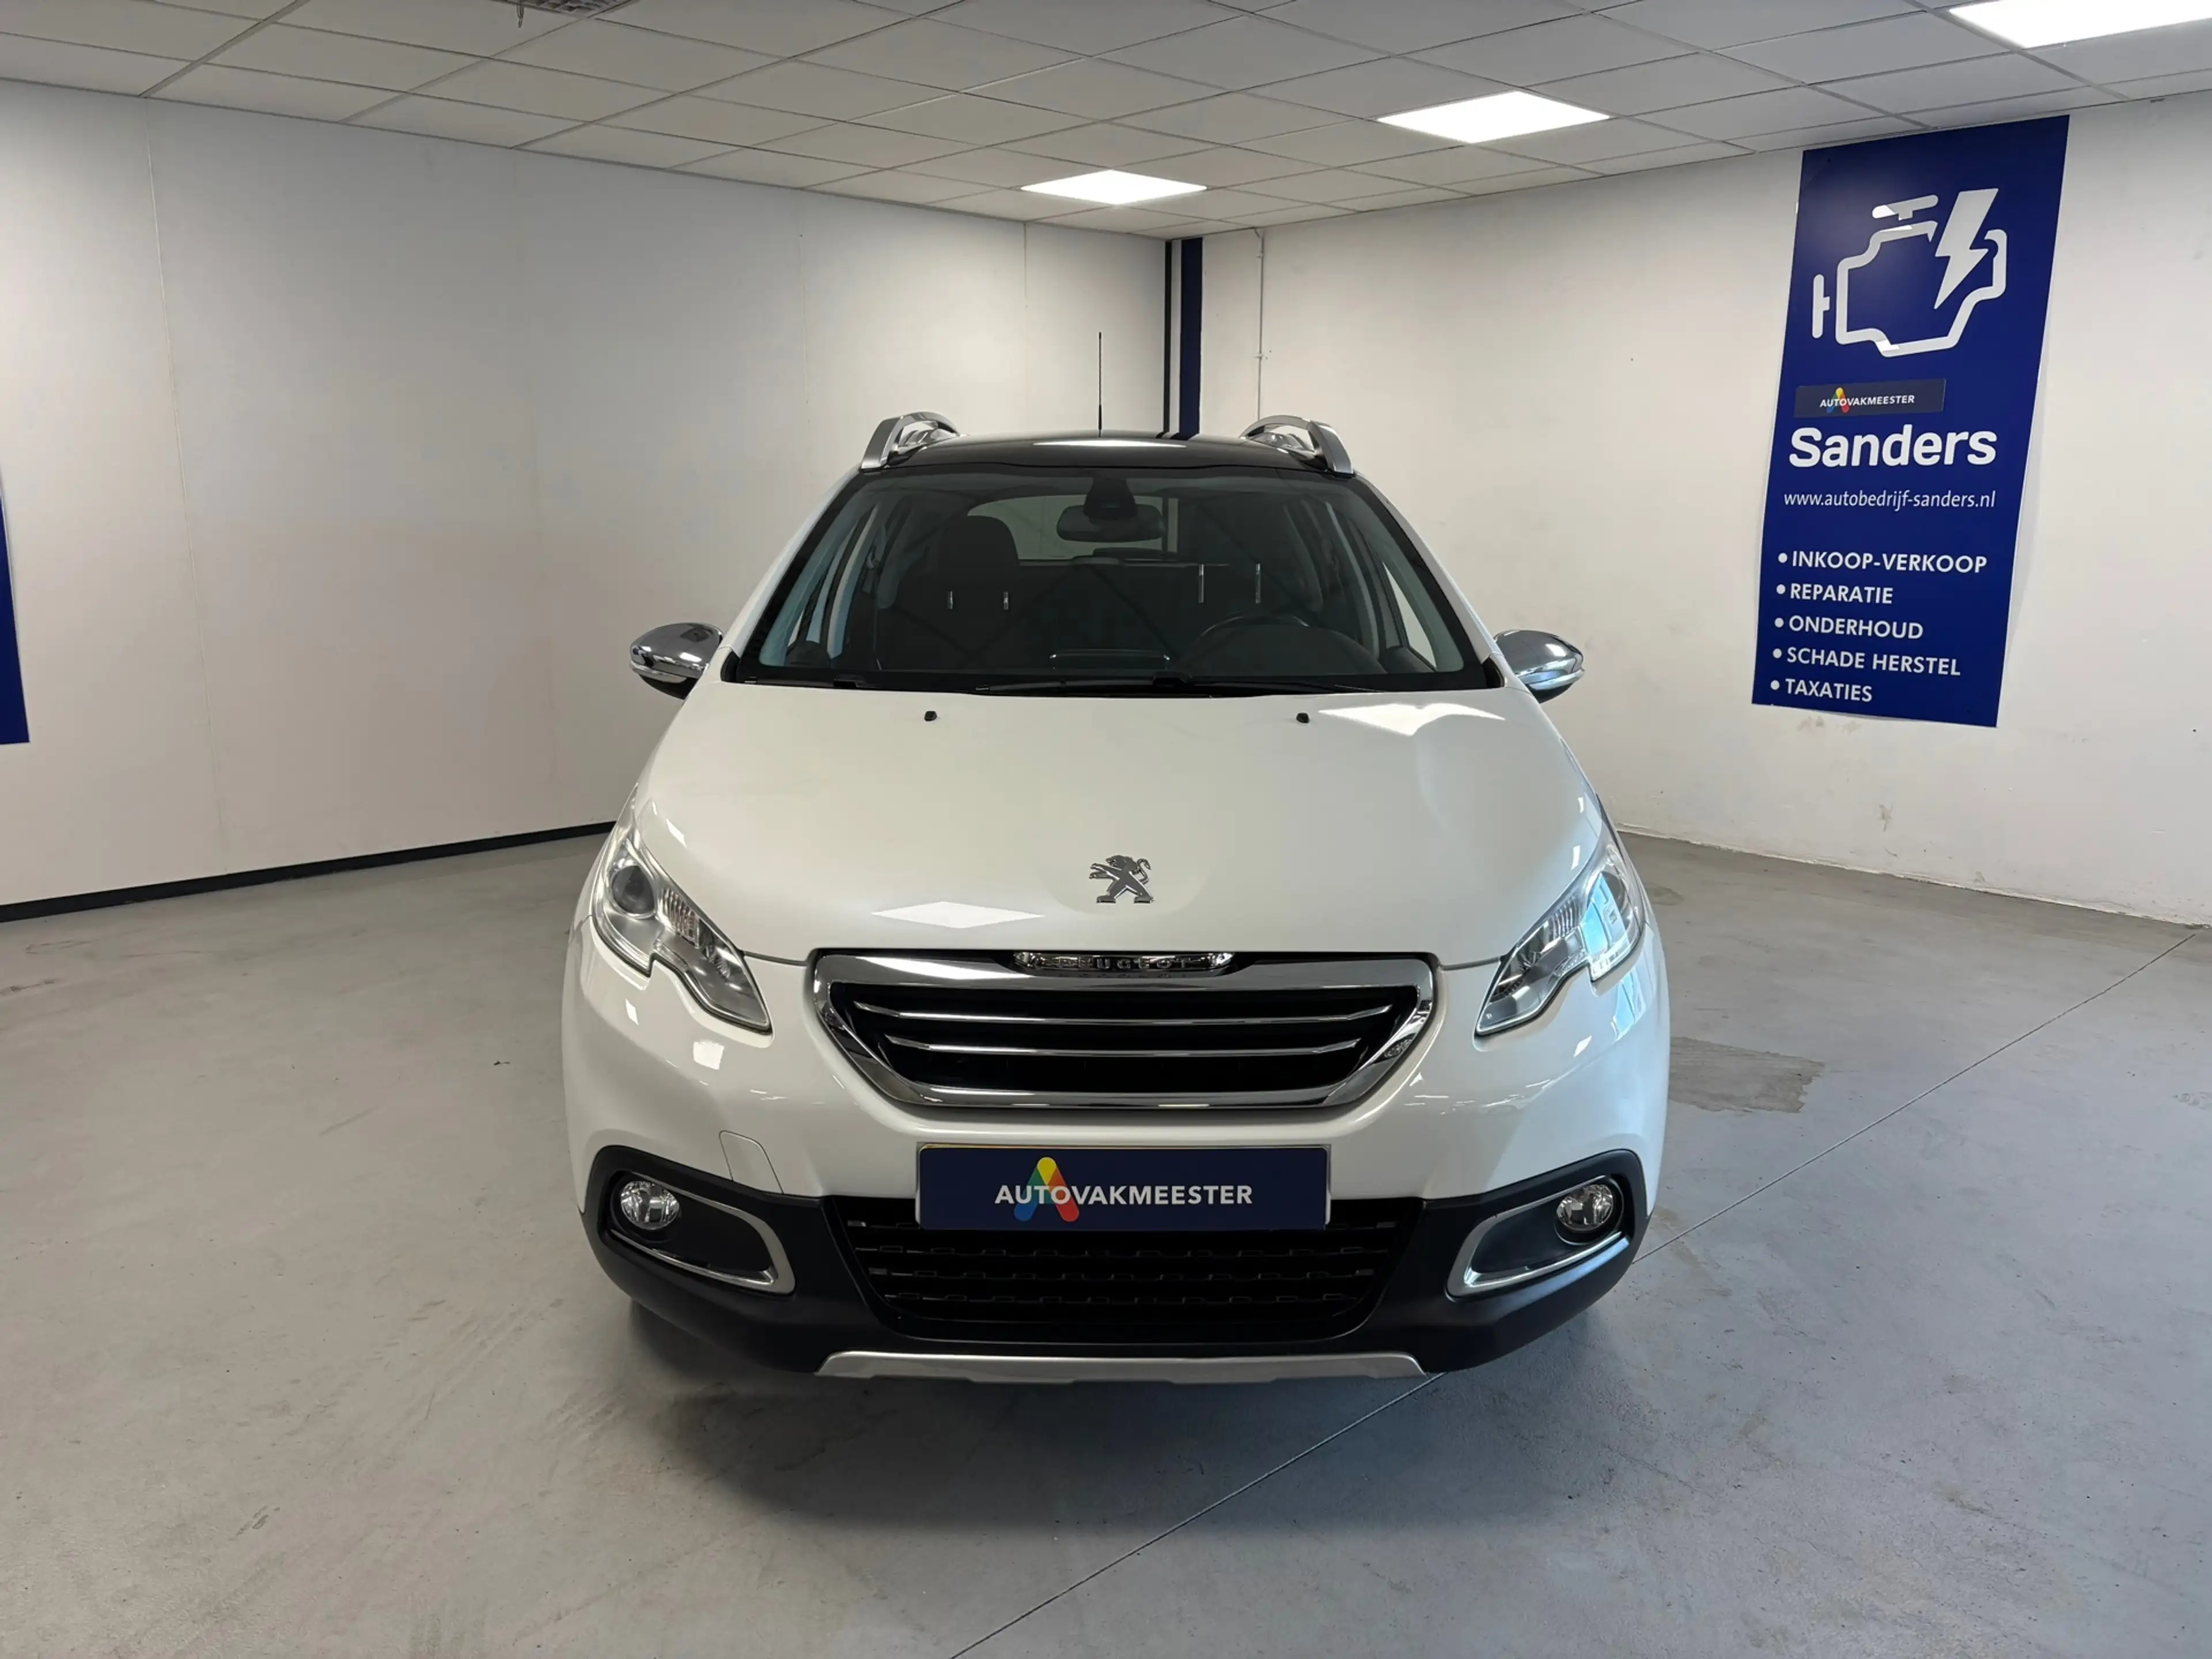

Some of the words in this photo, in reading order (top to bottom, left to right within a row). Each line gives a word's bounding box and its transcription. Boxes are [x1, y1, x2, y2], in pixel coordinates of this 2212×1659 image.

[1819, 395, 1915, 408] AUTOVAKMEESTER
[1789, 424, 1998, 468] Sanders
[1784, 490, 1996, 512] www.autobedrijf-sanders.nl
[1792, 551, 1987, 573] INKOOP-VERKOOP
[1790, 583, 1893, 604] REPARATIE
[1789, 615, 1924, 639] ONDERHOUD
[1787, 647, 1865, 669] SCHADE
[1872, 653, 1961, 676] HERSTEL
[1785, 678, 1873, 702] TAXATIES
[994, 1185, 1252, 1205] AUTOVAKMEESTER
